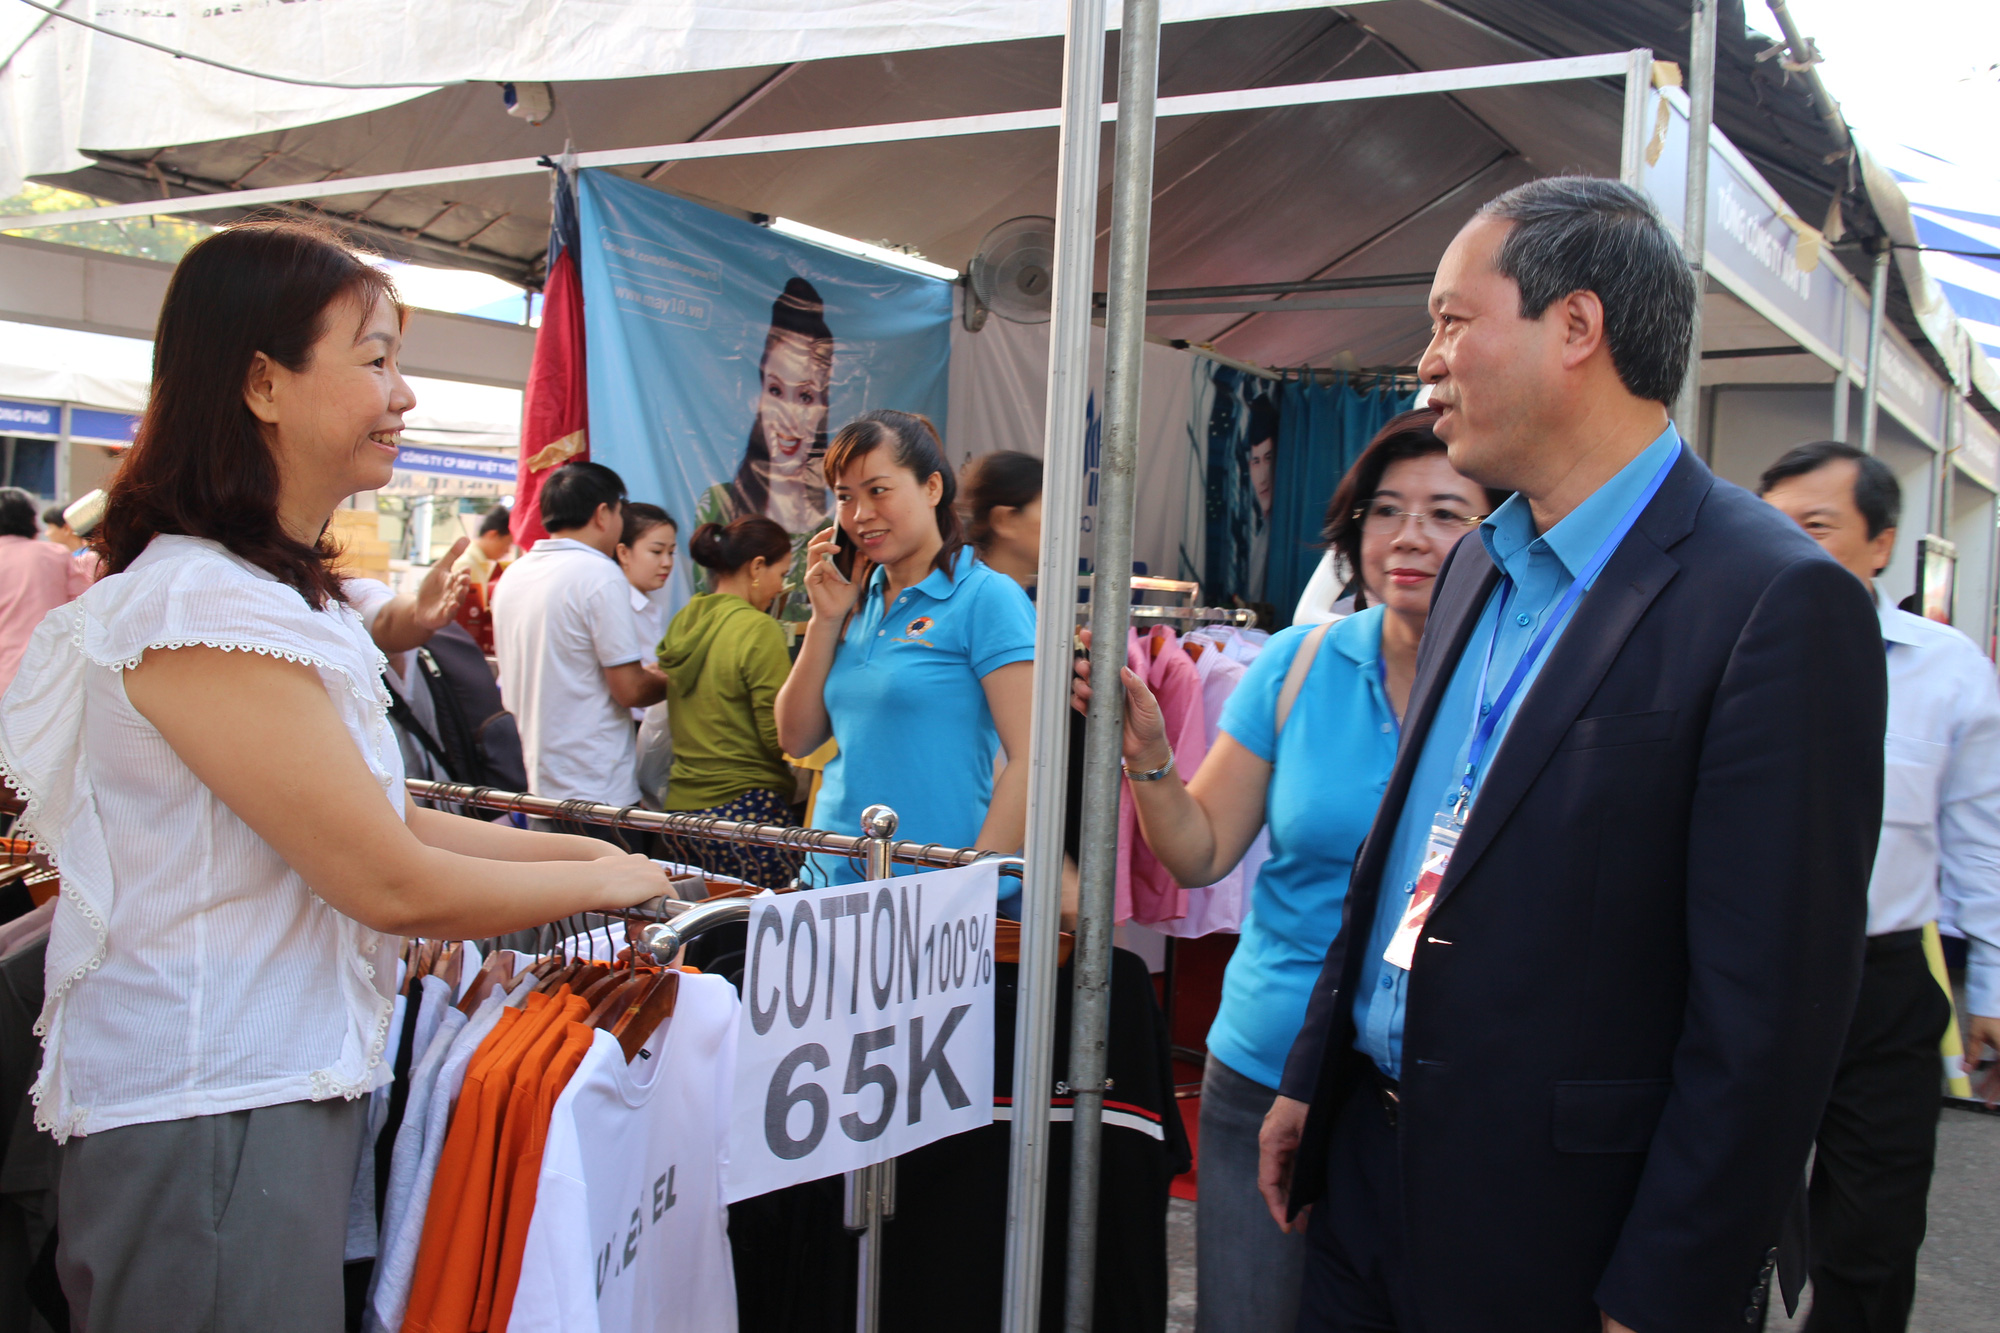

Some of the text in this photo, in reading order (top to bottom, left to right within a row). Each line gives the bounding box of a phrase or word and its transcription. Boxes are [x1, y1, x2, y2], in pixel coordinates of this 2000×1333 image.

[614, 286, 705, 319] www.may10.vn
[400, 450, 430, 466] CÔNG
[430, 454, 443, 467] TY
[443, 456, 457, 468] CP
[750, 884, 992, 1035] COTTON 100%
[764, 1003, 973, 1160] 65K
